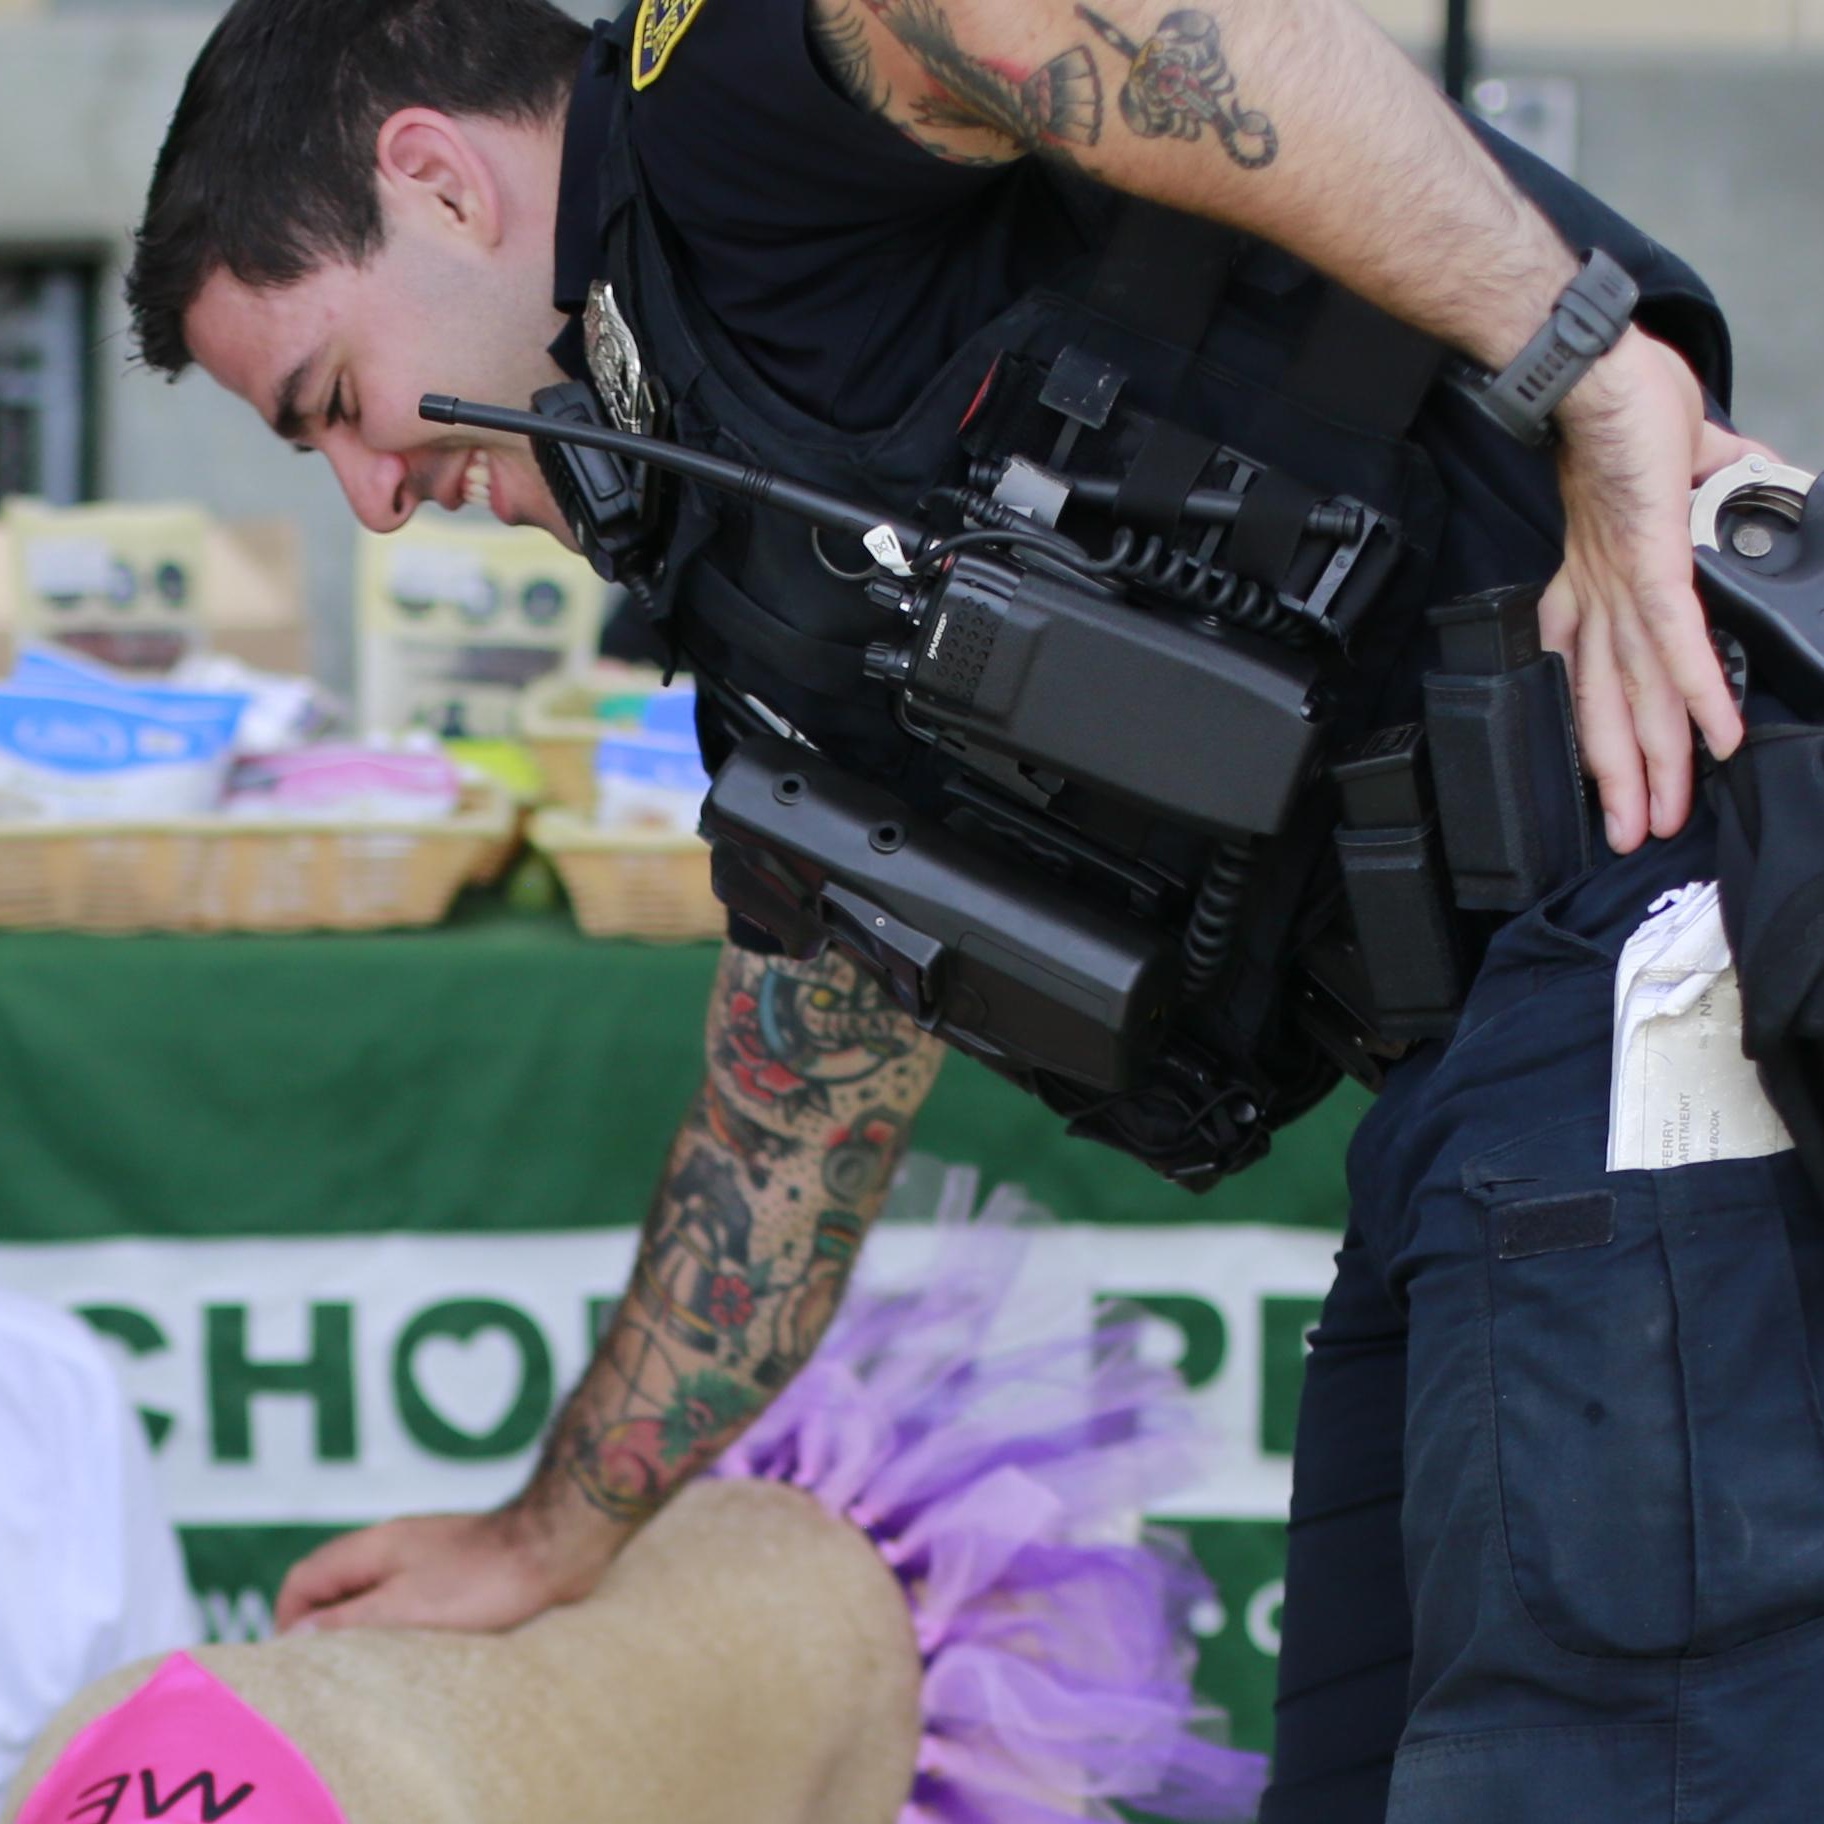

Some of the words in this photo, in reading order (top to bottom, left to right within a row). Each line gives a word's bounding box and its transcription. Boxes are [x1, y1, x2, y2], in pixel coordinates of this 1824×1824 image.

[1661, 1119, 1675, 1167] FERRY
[1709, 1110, 1721, 1145] BOOK
[78, 1297, 618, 1463] CHO
